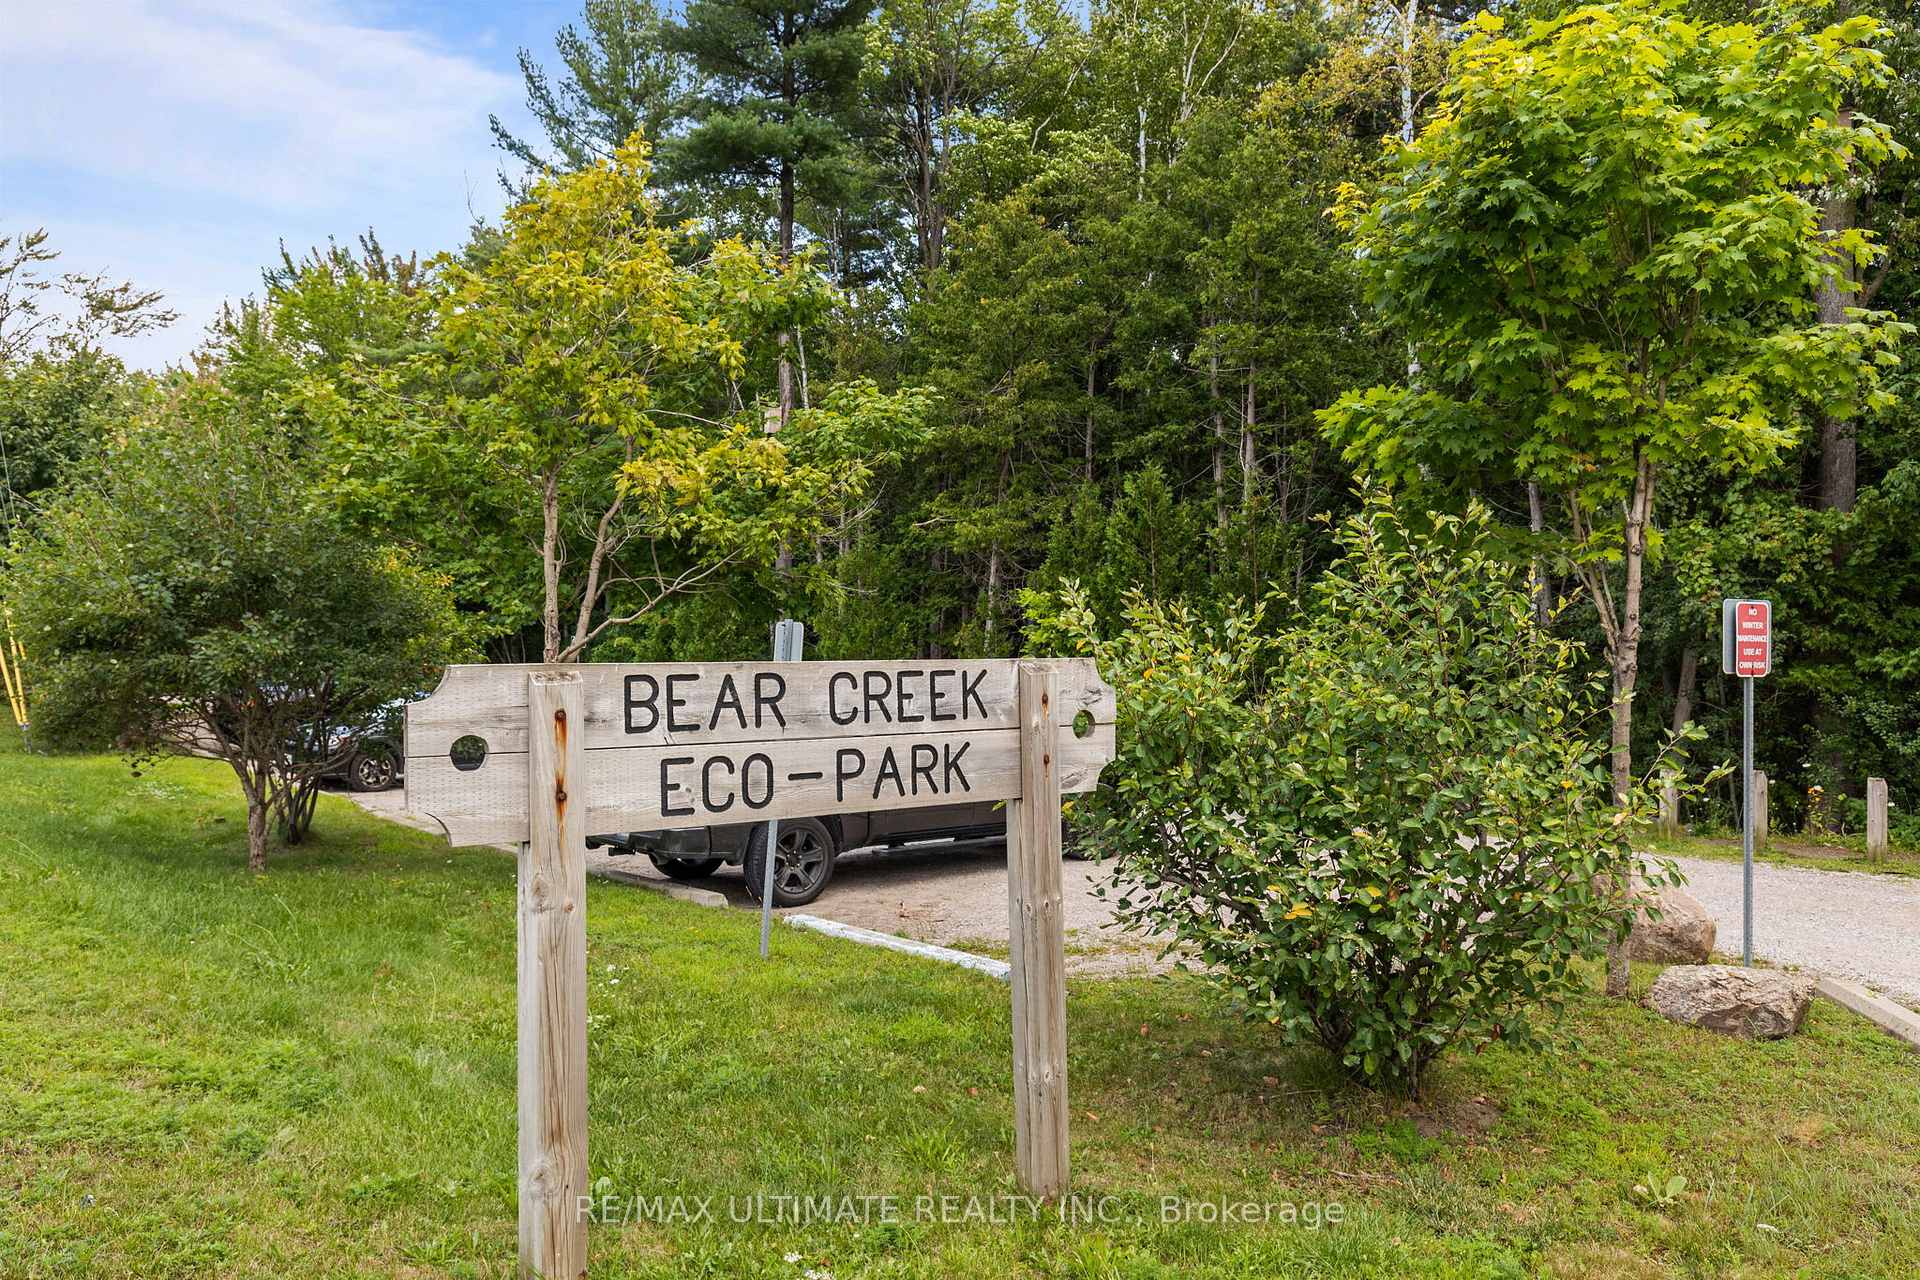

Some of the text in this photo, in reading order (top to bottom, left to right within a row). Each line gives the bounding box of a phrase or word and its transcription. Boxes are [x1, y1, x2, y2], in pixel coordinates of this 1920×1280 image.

[1748, 608, 1758, 616] NO
[1742, 621, 1763, 629] WINTER
[1743, 648, 1762, 656] USE AT
[1739, 661, 1766, 669] OWN RISK
[623, 669, 988, 734] BEAR CREEK
[660, 741, 972, 818] ECO-PARK
